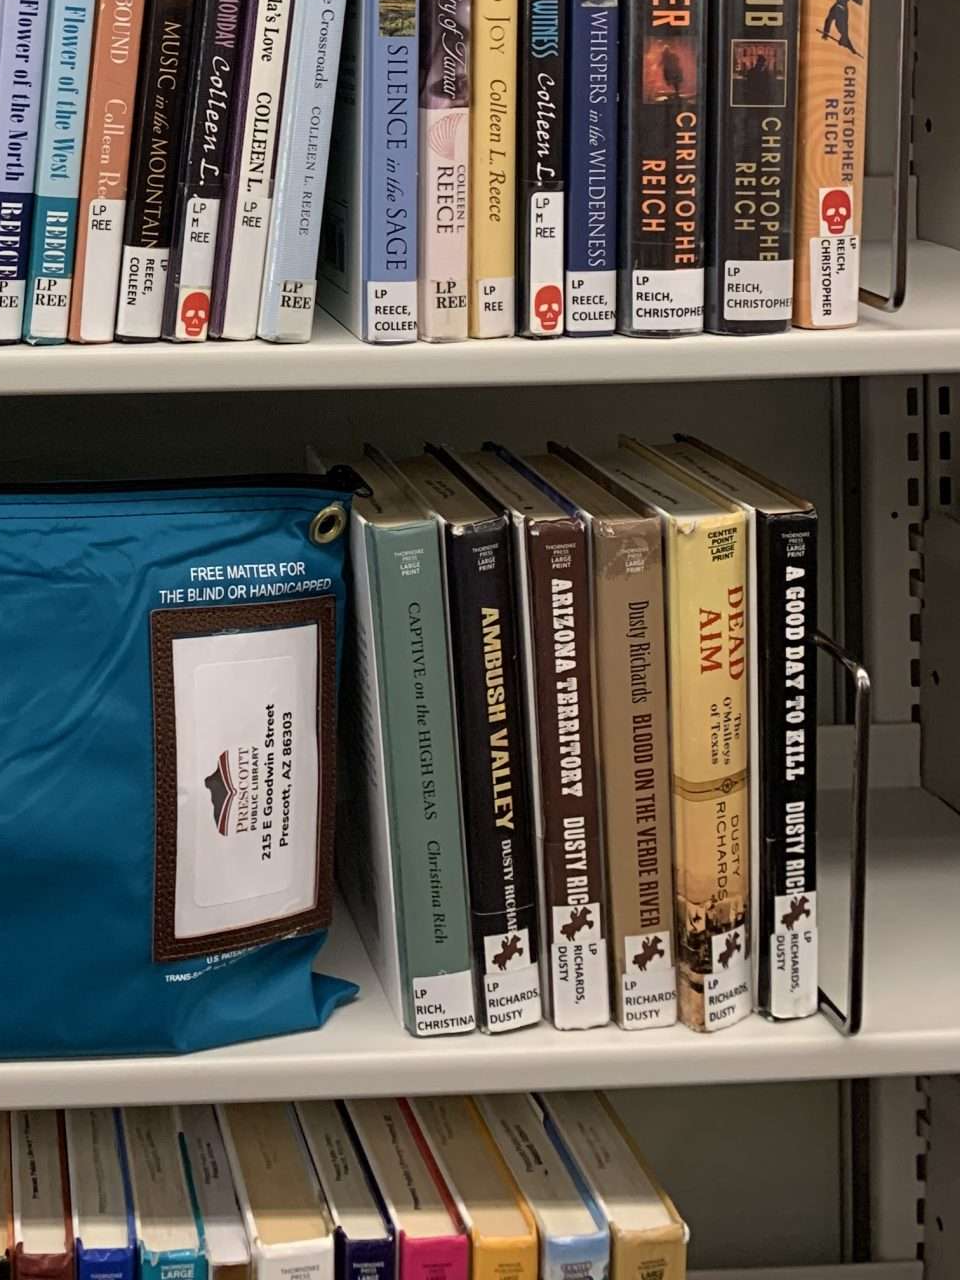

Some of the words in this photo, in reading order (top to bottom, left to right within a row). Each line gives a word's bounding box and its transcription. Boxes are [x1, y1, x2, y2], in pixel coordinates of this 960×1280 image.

[261, 26, 280, 62] Love
[483, 15, 509, 55] JOY
[530, 0, 558, 58] WITNESS
[386, 45, 409, 149] SILENCE
[386, 158, 398, 173] in
[386, 174, 400, 205] the
[386, 209, 407, 270] SAGE
[160, 590, 186, 603] THE
[188, 586, 225, 602] BLIND
[227, 584, 247, 598] OR
[250, 579, 331, 597] HANDICAPPED
[190, 566, 225, 581] FREE
[227, 563, 277, 579] MATTER
[280, 562, 305, 577] FOR
[785, 566, 804, 582] A
[551, 578, 577, 674] ARIZONA
[727, 586, 743, 680] DEAD
[785, 586, 804, 641] GOOD
[699, 608, 722, 674] AIM
[481, 607, 509, 723] AMBUSH
[784, 645, 804, 691] DAY
[264, 704, 275, 748] Street
[282, 711, 293, 757] 86303
[785, 695, 804, 727] TO
[555, 678, 584, 797] TERRITORY
[785, 730, 804, 781] KILL
[236, 747, 249, 834] PRESCOTT
[251, 746, 259, 791] LIBRARY
[263, 752, 275, 817] Goodwin
[282, 760, 292, 780] AZ
[489, 728, 514, 829] VALLEY
[263, 821, 272, 830] E
[280, 783, 292, 847] Prescott,
[262, 833, 272, 861] 215
